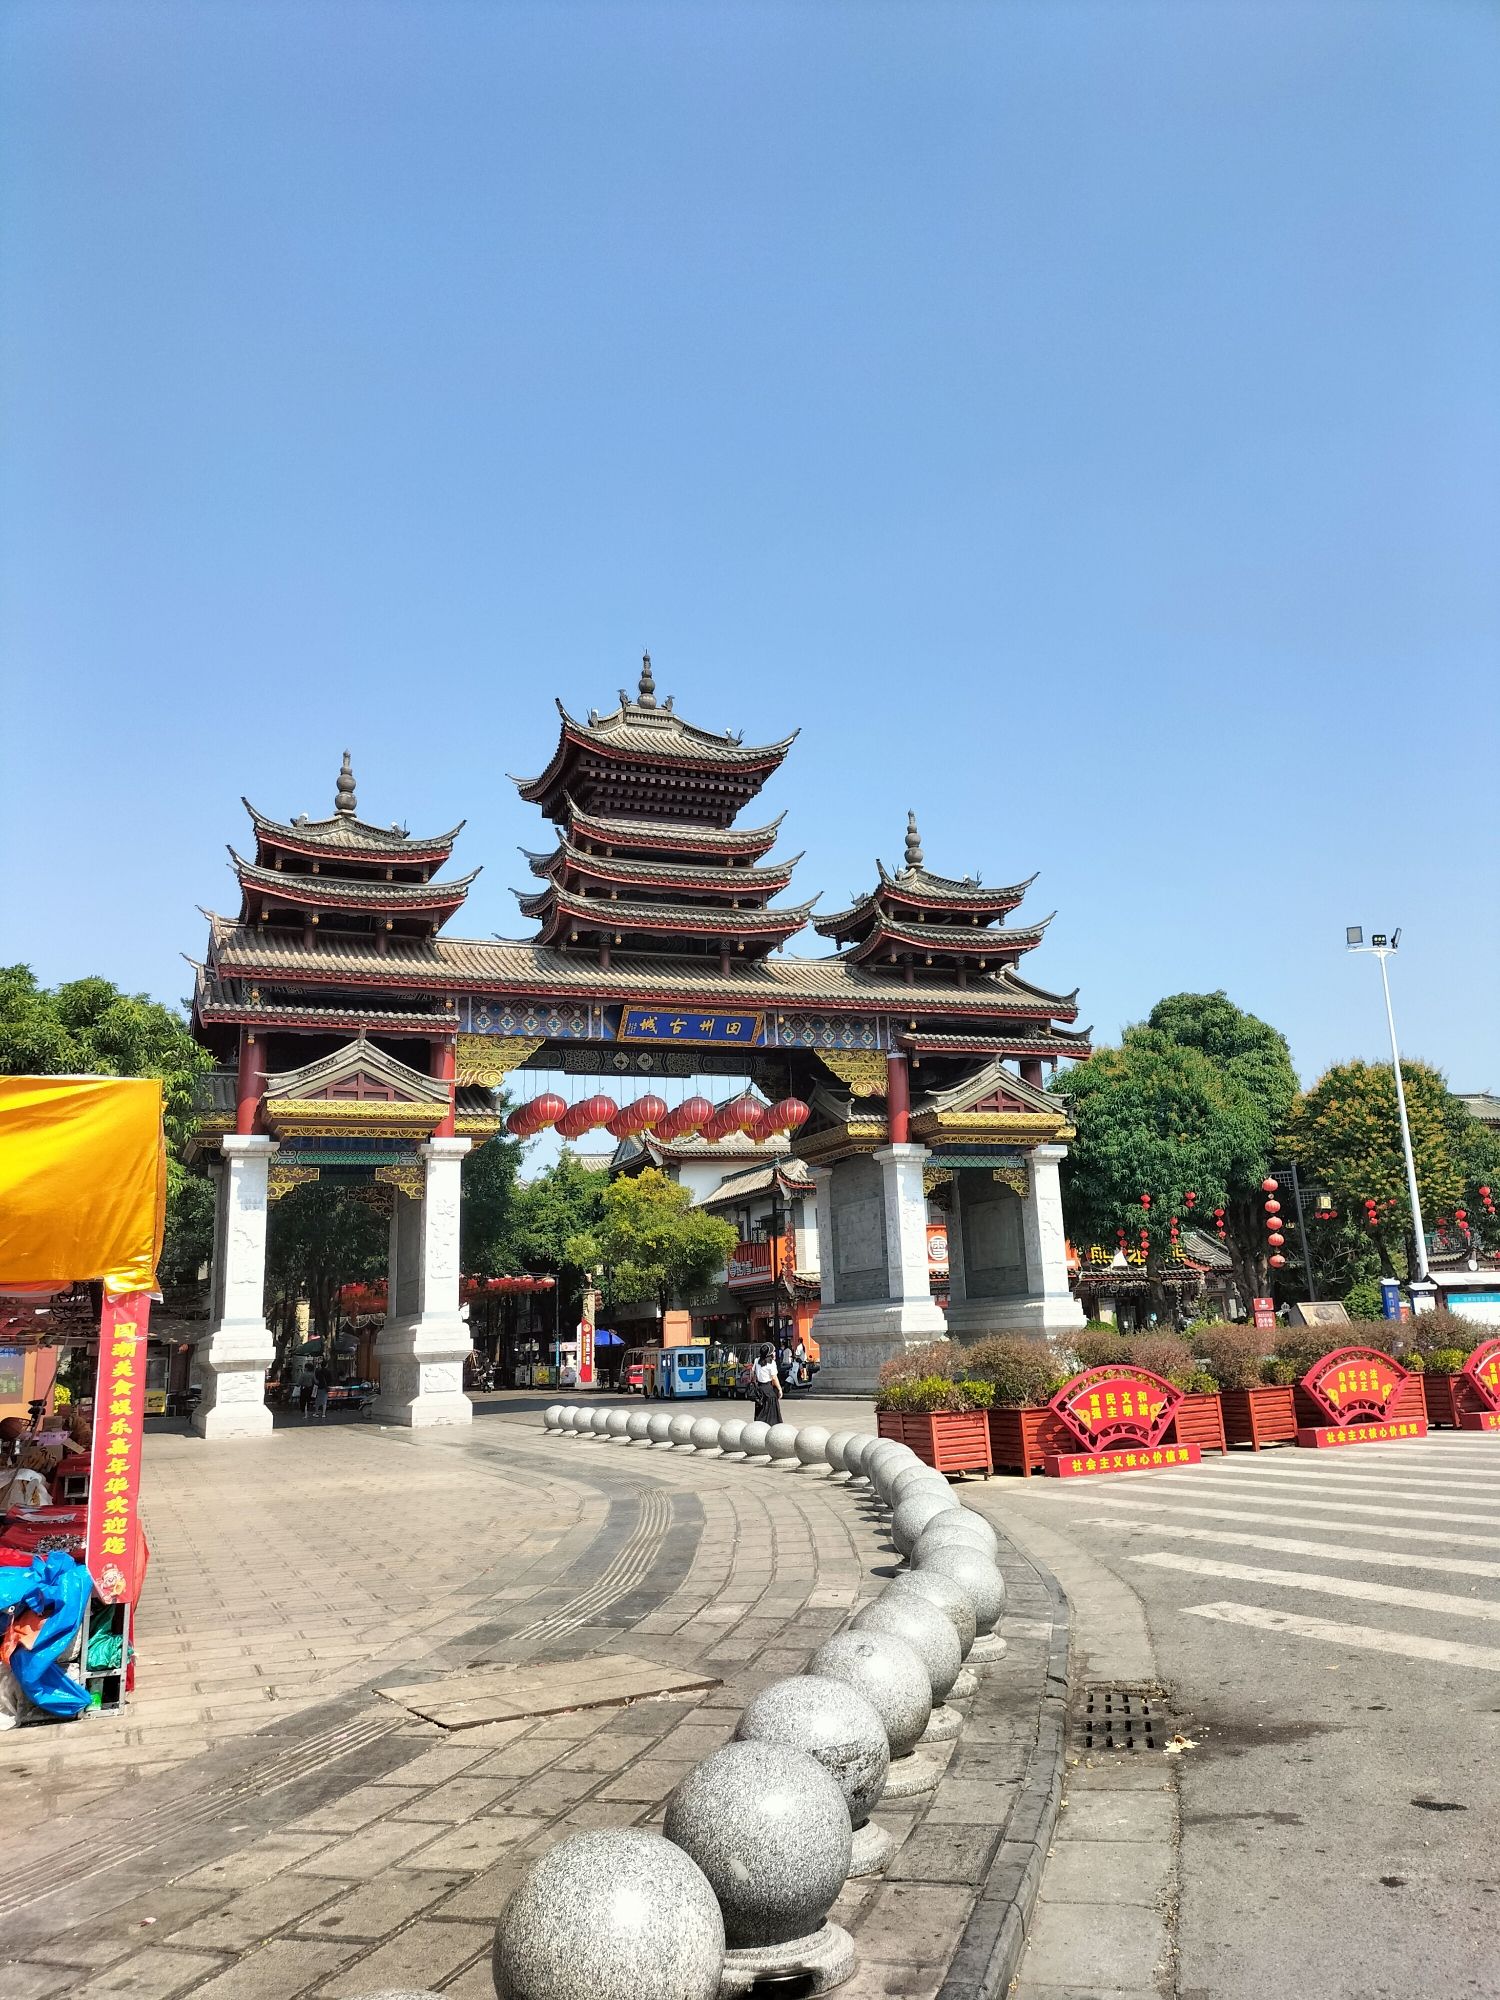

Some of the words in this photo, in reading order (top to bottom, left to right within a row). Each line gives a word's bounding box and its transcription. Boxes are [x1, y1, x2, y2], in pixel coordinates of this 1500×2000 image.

[640, 1016, 742, 1038] 田州古城
[102, 1321, 138, 1555] 国潮美食娱乐嘉年华欢迎您
[1326, 1423, 1419, 1443] 社会主义核心价值观
[1072, 1448, 1190, 1473] 社会主义核心价值观
